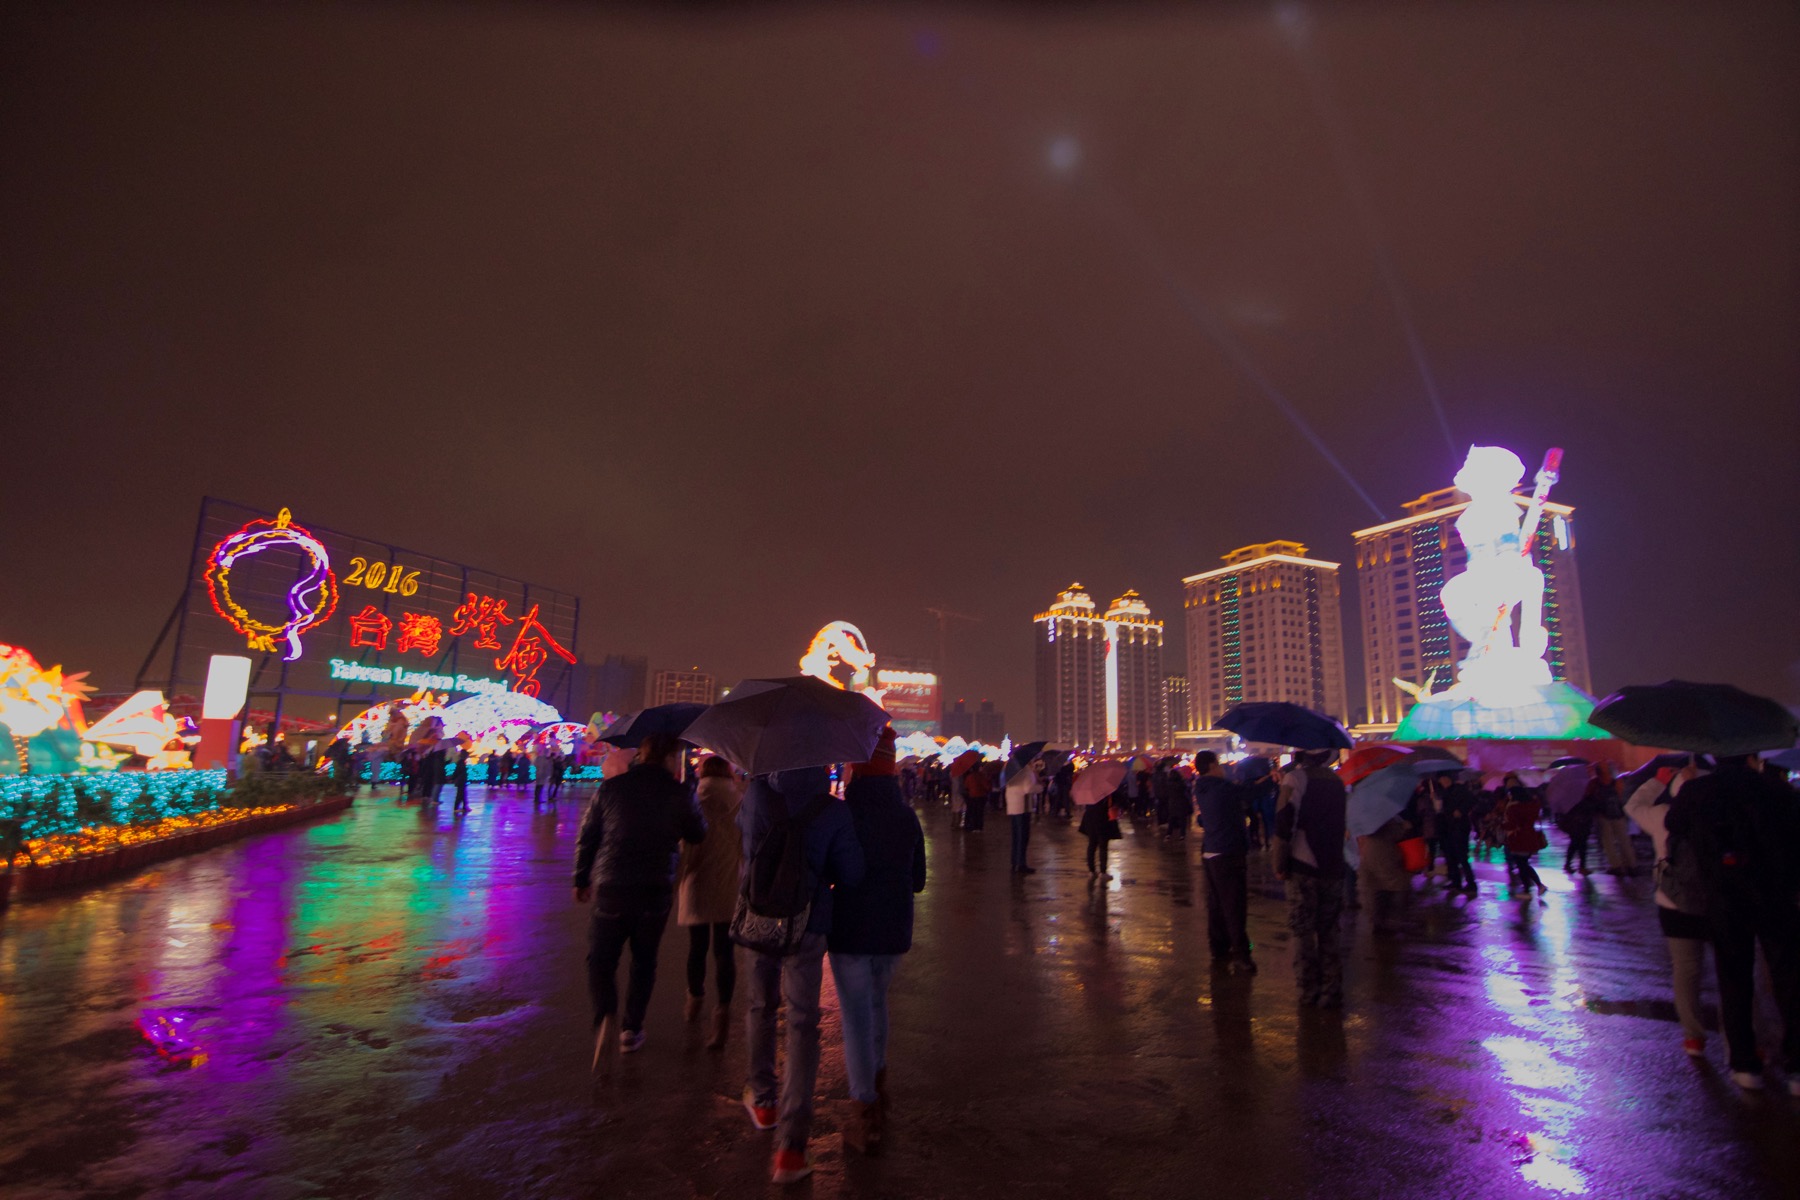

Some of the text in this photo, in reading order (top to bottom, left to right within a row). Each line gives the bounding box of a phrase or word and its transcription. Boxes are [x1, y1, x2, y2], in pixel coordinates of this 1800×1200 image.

[342, 556, 421, 597] 2016
[349, 592, 577, 699] 台灣燈會
[330, 659, 392, 683] Taiwan
[394, 666, 454, 689] Lantern
